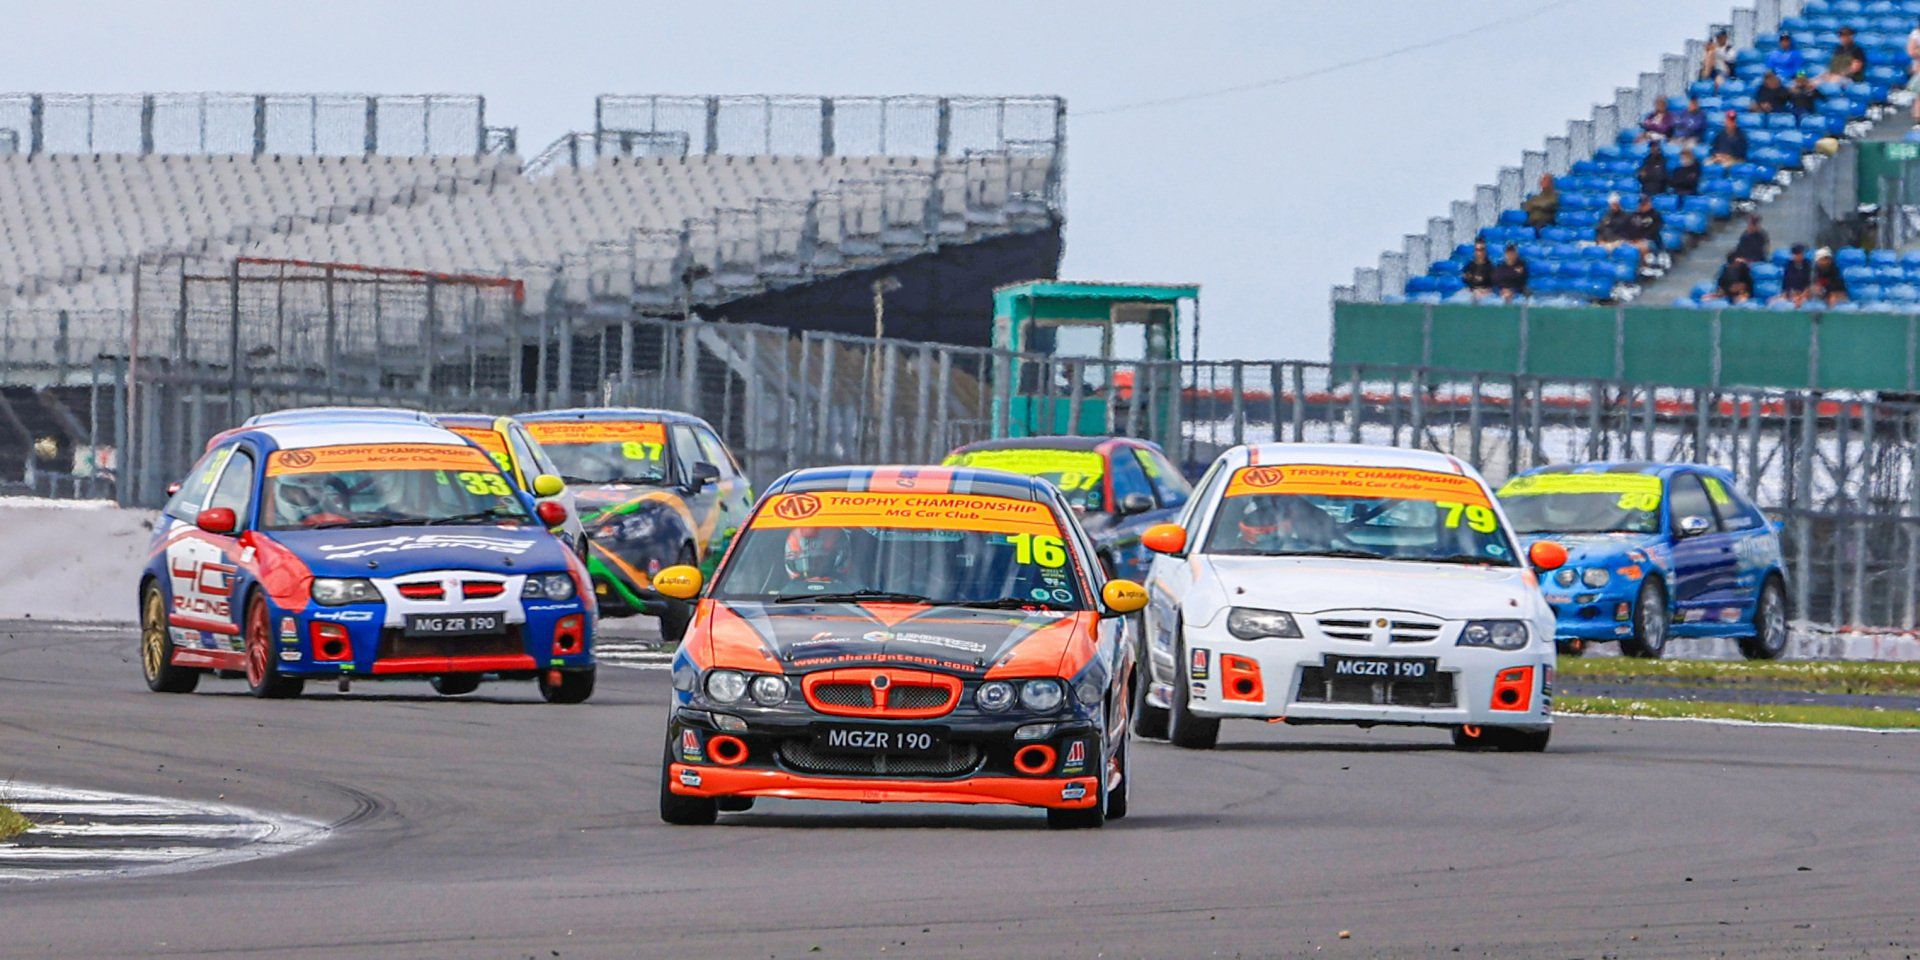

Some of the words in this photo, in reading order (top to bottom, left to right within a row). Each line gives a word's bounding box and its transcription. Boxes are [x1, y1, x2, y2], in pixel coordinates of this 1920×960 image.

[319, 448, 375, 457] TROPHY
[379, 446, 475, 458] CHAMPIONSHIP
[389, 454, 408, 463] Car
[411, 454, 438, 463] Club
[621, 441, 663, 461] 87
[460, 472, 512, 496] 33
[1058, 472, 1104, 492] 97
[1244, 468, 1282, 486] MG
[1289, 469, 1349, 478] TROPHY
[1355, 471, 1468, 486] CHAMPIONSHIP
[1340, 479, 1362, 487] MG
[1365, 480, 1389, 489] Car
[1390, 482, 1422, 491] Club
[777, 494, 819, 519] MG
[829, 496, 900, 507] TROPHY
[905, 497, 1038, 514] CHAMPIONSHIP
[1616, 492, 1661, 512] 80
[884, 508, 911, 518] MG
[915, 509, 941, 518] Car
[945, 510, 980, 520] Club
[1434, 500, 1499, 534] 79
[1006, 532, 1067, 569] 16
[173, 595, 231, 617] RACING
[415, 617, 443, 632] MG
[446, 617, 466, 631] ZR
[470, 616, 496, 631] 190
[1335, 659, 1388, 676] MGZR
[1393, 661, 1426, 678] 190
[828, 729, 890, 749] MGZR
[896, 731, 932, 750] 190
